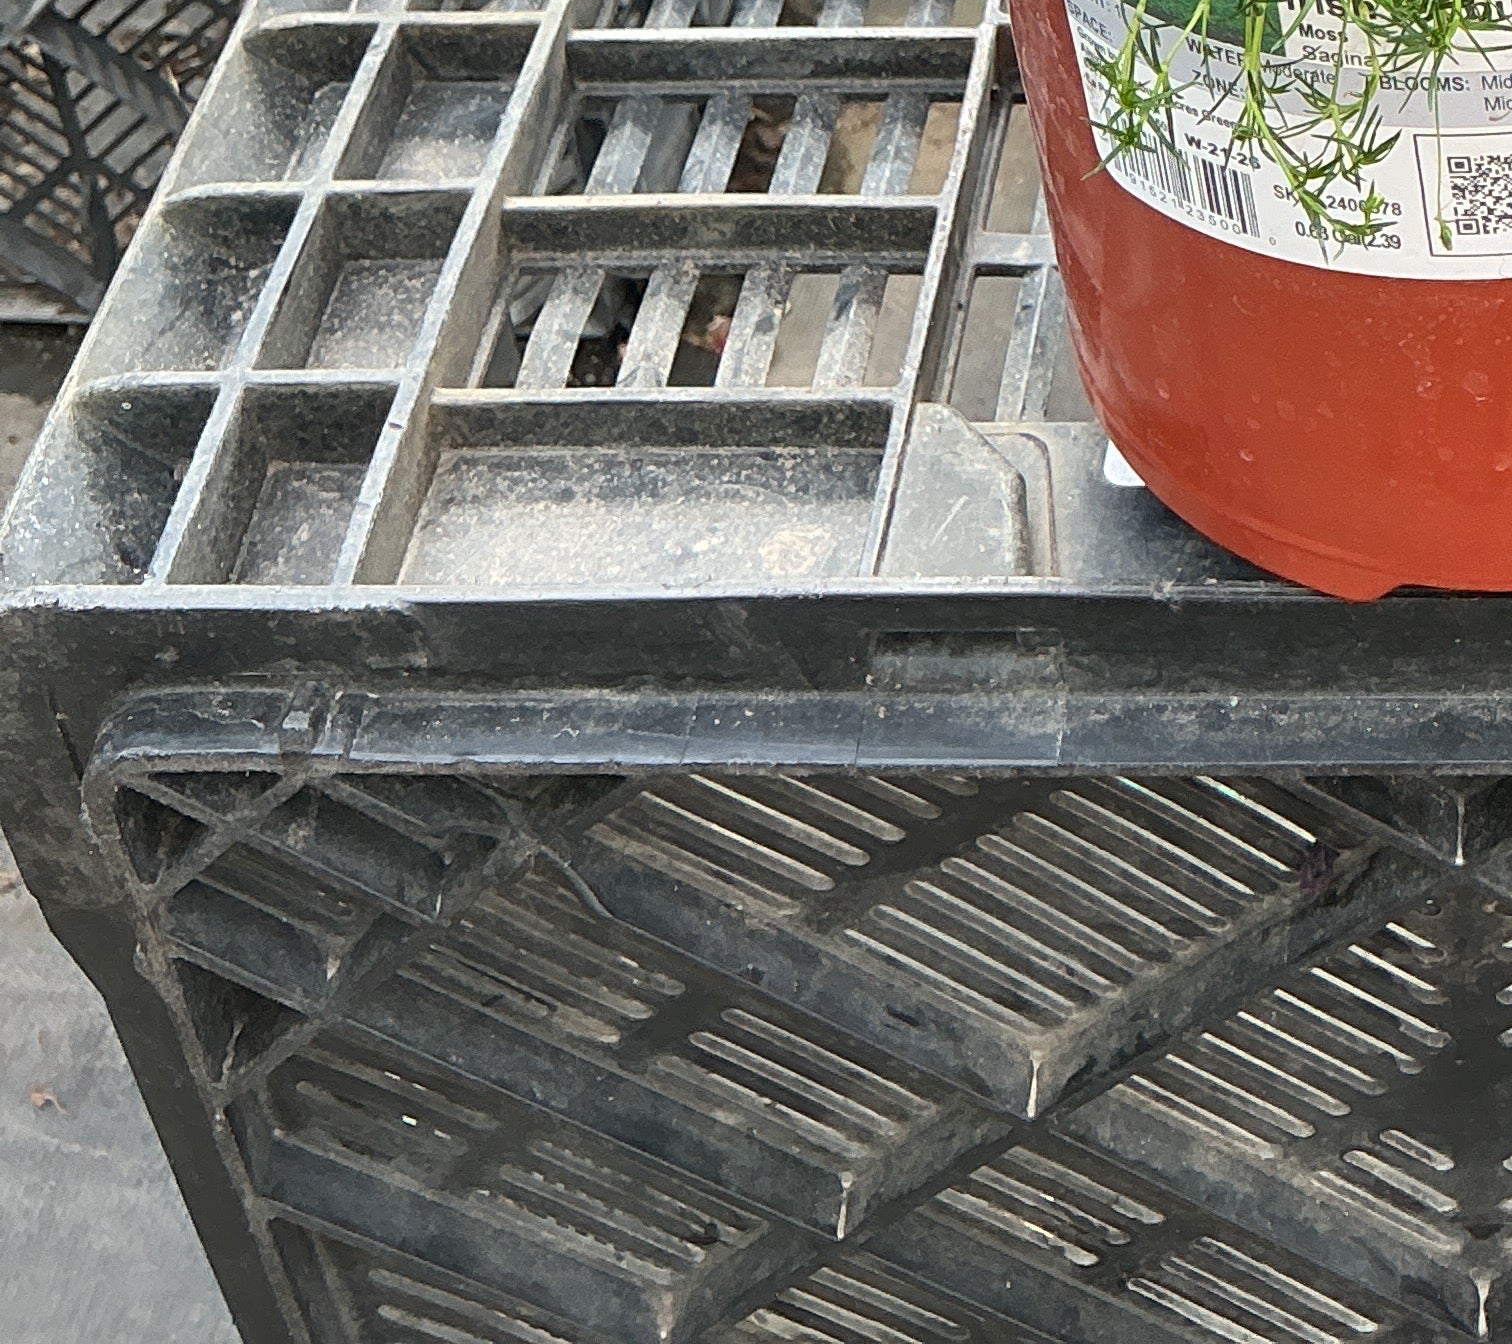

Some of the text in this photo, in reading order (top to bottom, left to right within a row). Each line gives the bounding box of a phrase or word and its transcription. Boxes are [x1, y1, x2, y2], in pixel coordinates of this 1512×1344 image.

[1298, 23, 1348, 43] Moss
[1301, 44, 1374, 68] Sagina
[1379, 75, 1470, 91] BLOOMS:
[1183, 132, 1262, 170] W-21-26
